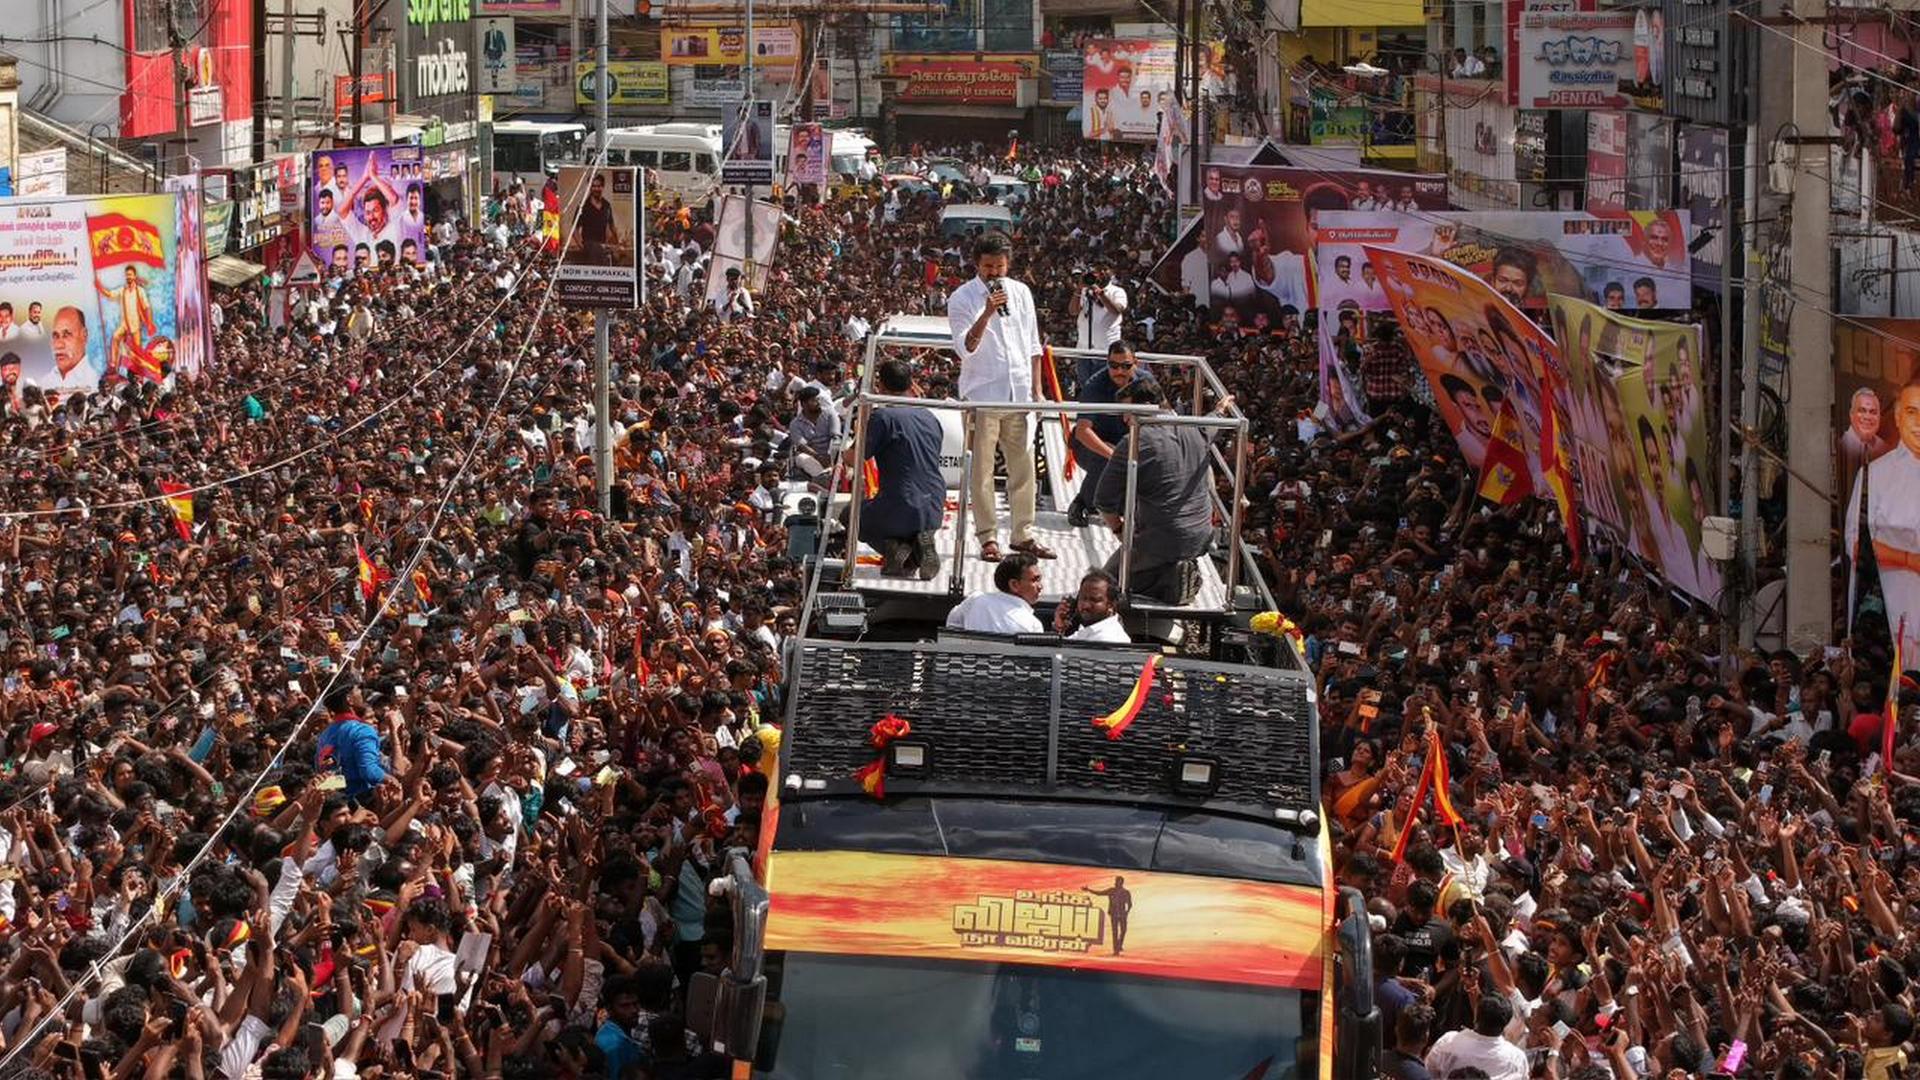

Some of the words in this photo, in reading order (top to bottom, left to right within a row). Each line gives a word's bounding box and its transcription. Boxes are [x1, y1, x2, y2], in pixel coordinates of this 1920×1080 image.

[418, 38, 468, 97] mobiles
[1550, 91, 1605, 105] DENTAL
[1015, 888, 1092, 906] உங்க
[953, 895, 1104, 945] விஜய்
[1004, 935, 1089, 952] வரேன்
